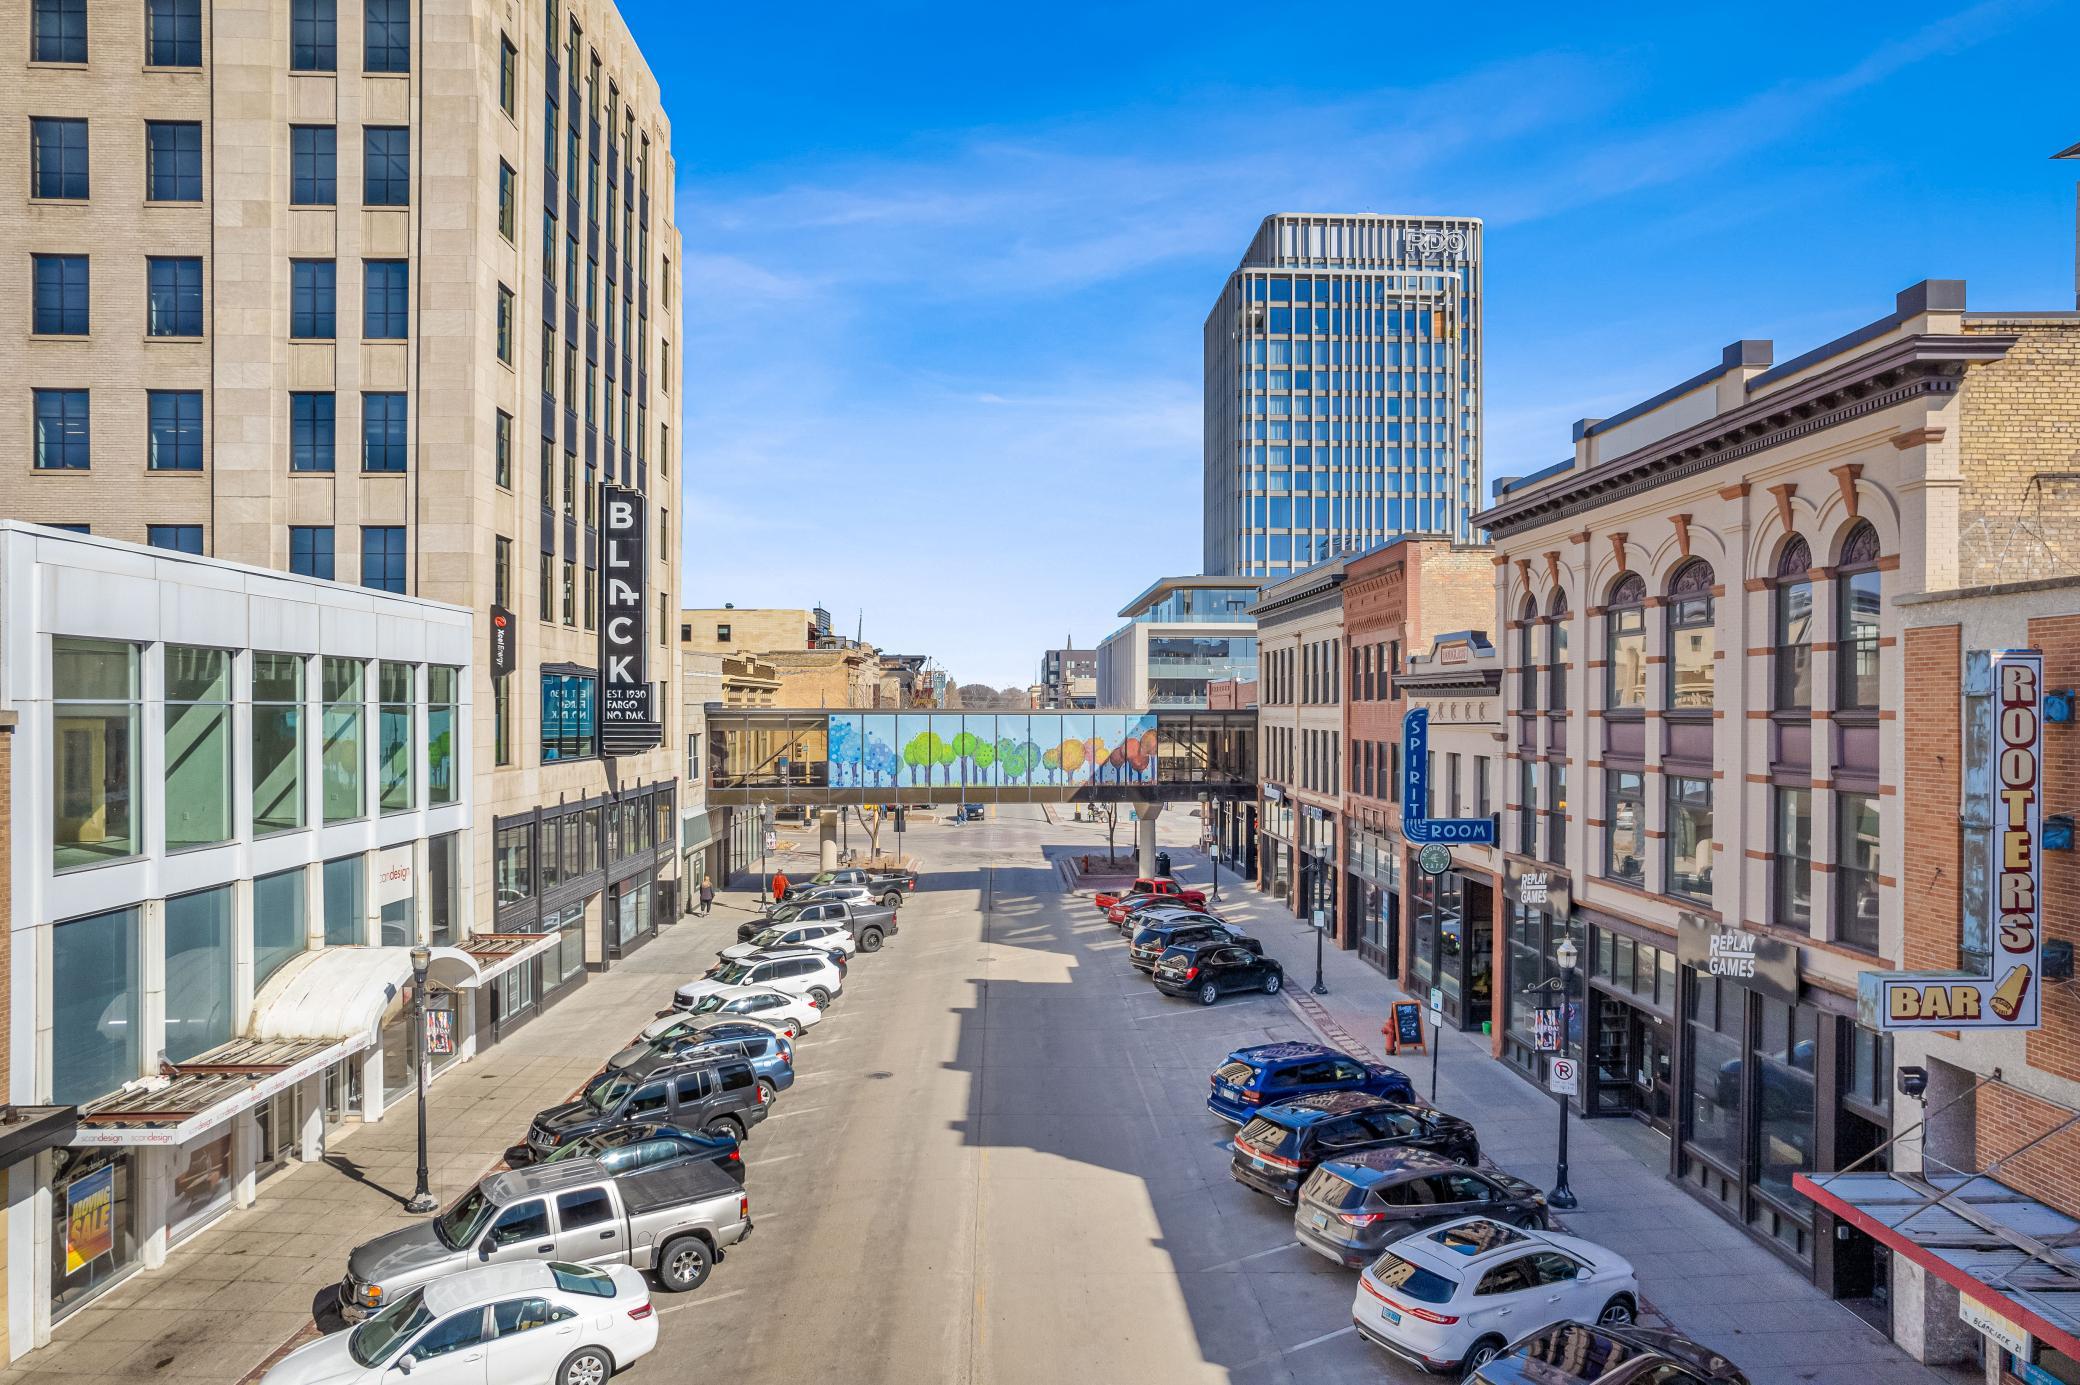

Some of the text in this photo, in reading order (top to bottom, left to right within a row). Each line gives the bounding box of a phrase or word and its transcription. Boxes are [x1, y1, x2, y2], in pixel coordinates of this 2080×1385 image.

[1406, 231, 1467, 252] RDO
[608, 502, 639, 683] BLACK
[607, 690, 646, 698] EST. 1930
[607, 701, 638, 709] FARGO
[607, 711, 646, 719] NO. DAK.
[1410, 720, 1421, 817] SPIRIT
[1999, 664, 2036, 954] ROOTERS
[1431, 824, 1486, 839] ROOM
[1521, 872, 1547, 892] REPLAY
[1521, 889, 1547, 904] GAMES
[1709, 935, 1756, 957] REPLAY
[1709, 957, 1755, 978] GAMES
[1890, 986, 1981, 1021] BAR
[81, 1133, 123, 1143] scandesign
[130, 1133, 173, 1143] scandesign
[73, 1186, 110, 1220] MOVING
[71, 1205, 110, 1243] SALE
[1973, 1317, 2022, 1353] BLACKJACK 21
